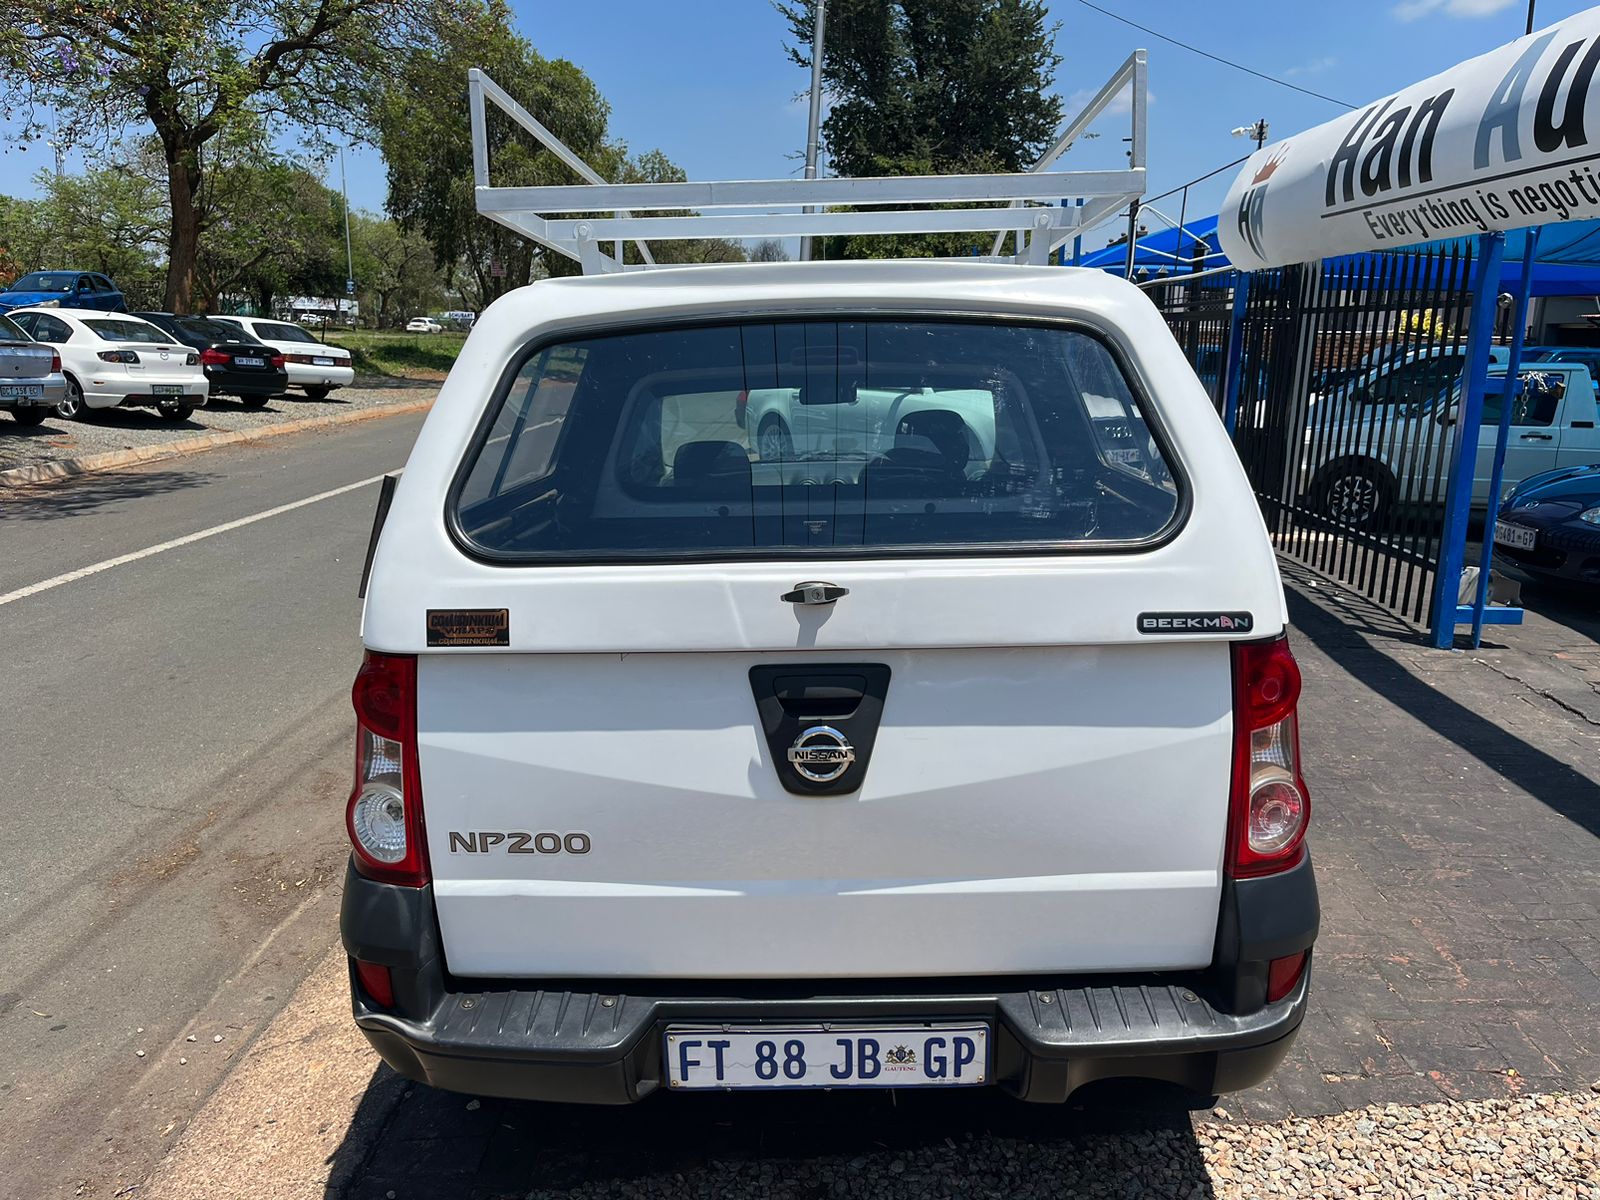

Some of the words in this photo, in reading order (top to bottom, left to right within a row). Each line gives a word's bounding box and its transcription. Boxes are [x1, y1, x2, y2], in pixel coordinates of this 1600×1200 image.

[1325, 87, 1455, 207] Han
[1363, 198, 1489, 240] Everything
[1475, 190, 1510, 220] is
[1508, 166, 1600, 220] negoti
[1522, 532, 1534, 546] GP
[1143, 615, 1249, 629] BEEKMAN
[794, 751, 848, 760] NISSAN
[449, 831, 591, 854] NP200
[679, 1039, 731, 1082] FT
[754, 1038, 807, 1080] 88
[829, 1037, 882, 1080] JB
[923, 1036, 976, 1079] GP
